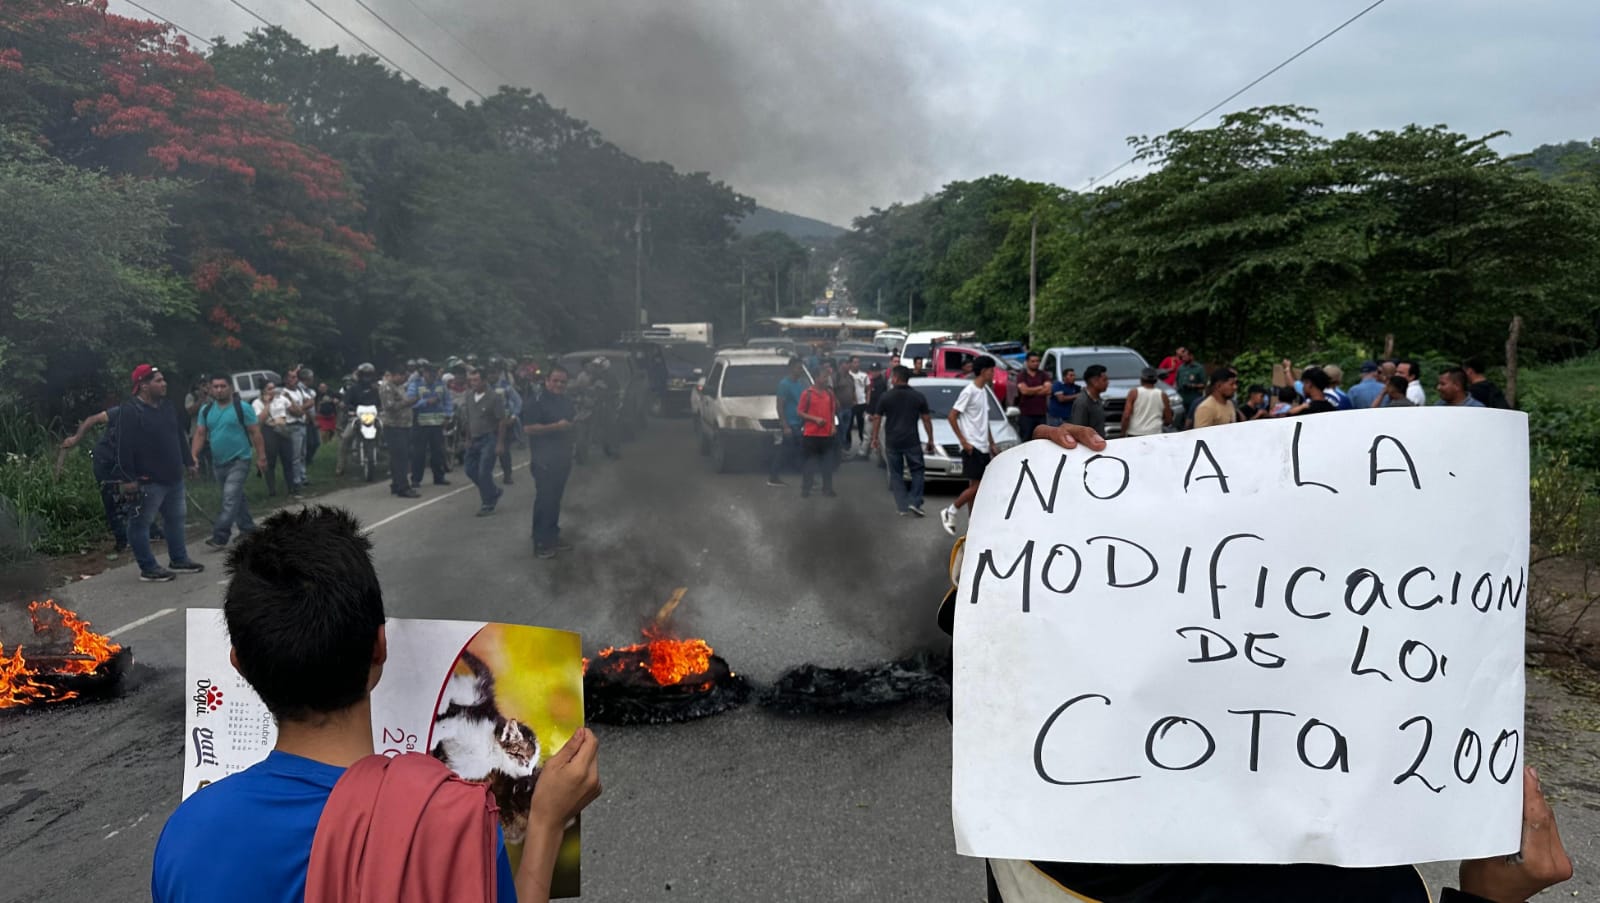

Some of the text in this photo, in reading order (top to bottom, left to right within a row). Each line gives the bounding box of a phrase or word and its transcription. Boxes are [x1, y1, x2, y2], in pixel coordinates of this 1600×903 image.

[1005, 453, 1130, 520] NO
[1184, 439, 1230, 493] A
[1176, 626, 1287, 669] DE
[193, 678, 212, 717] Dogui
[262, 712, 272, 746] Octubre
[1393, 715, 1520, 793] 200
